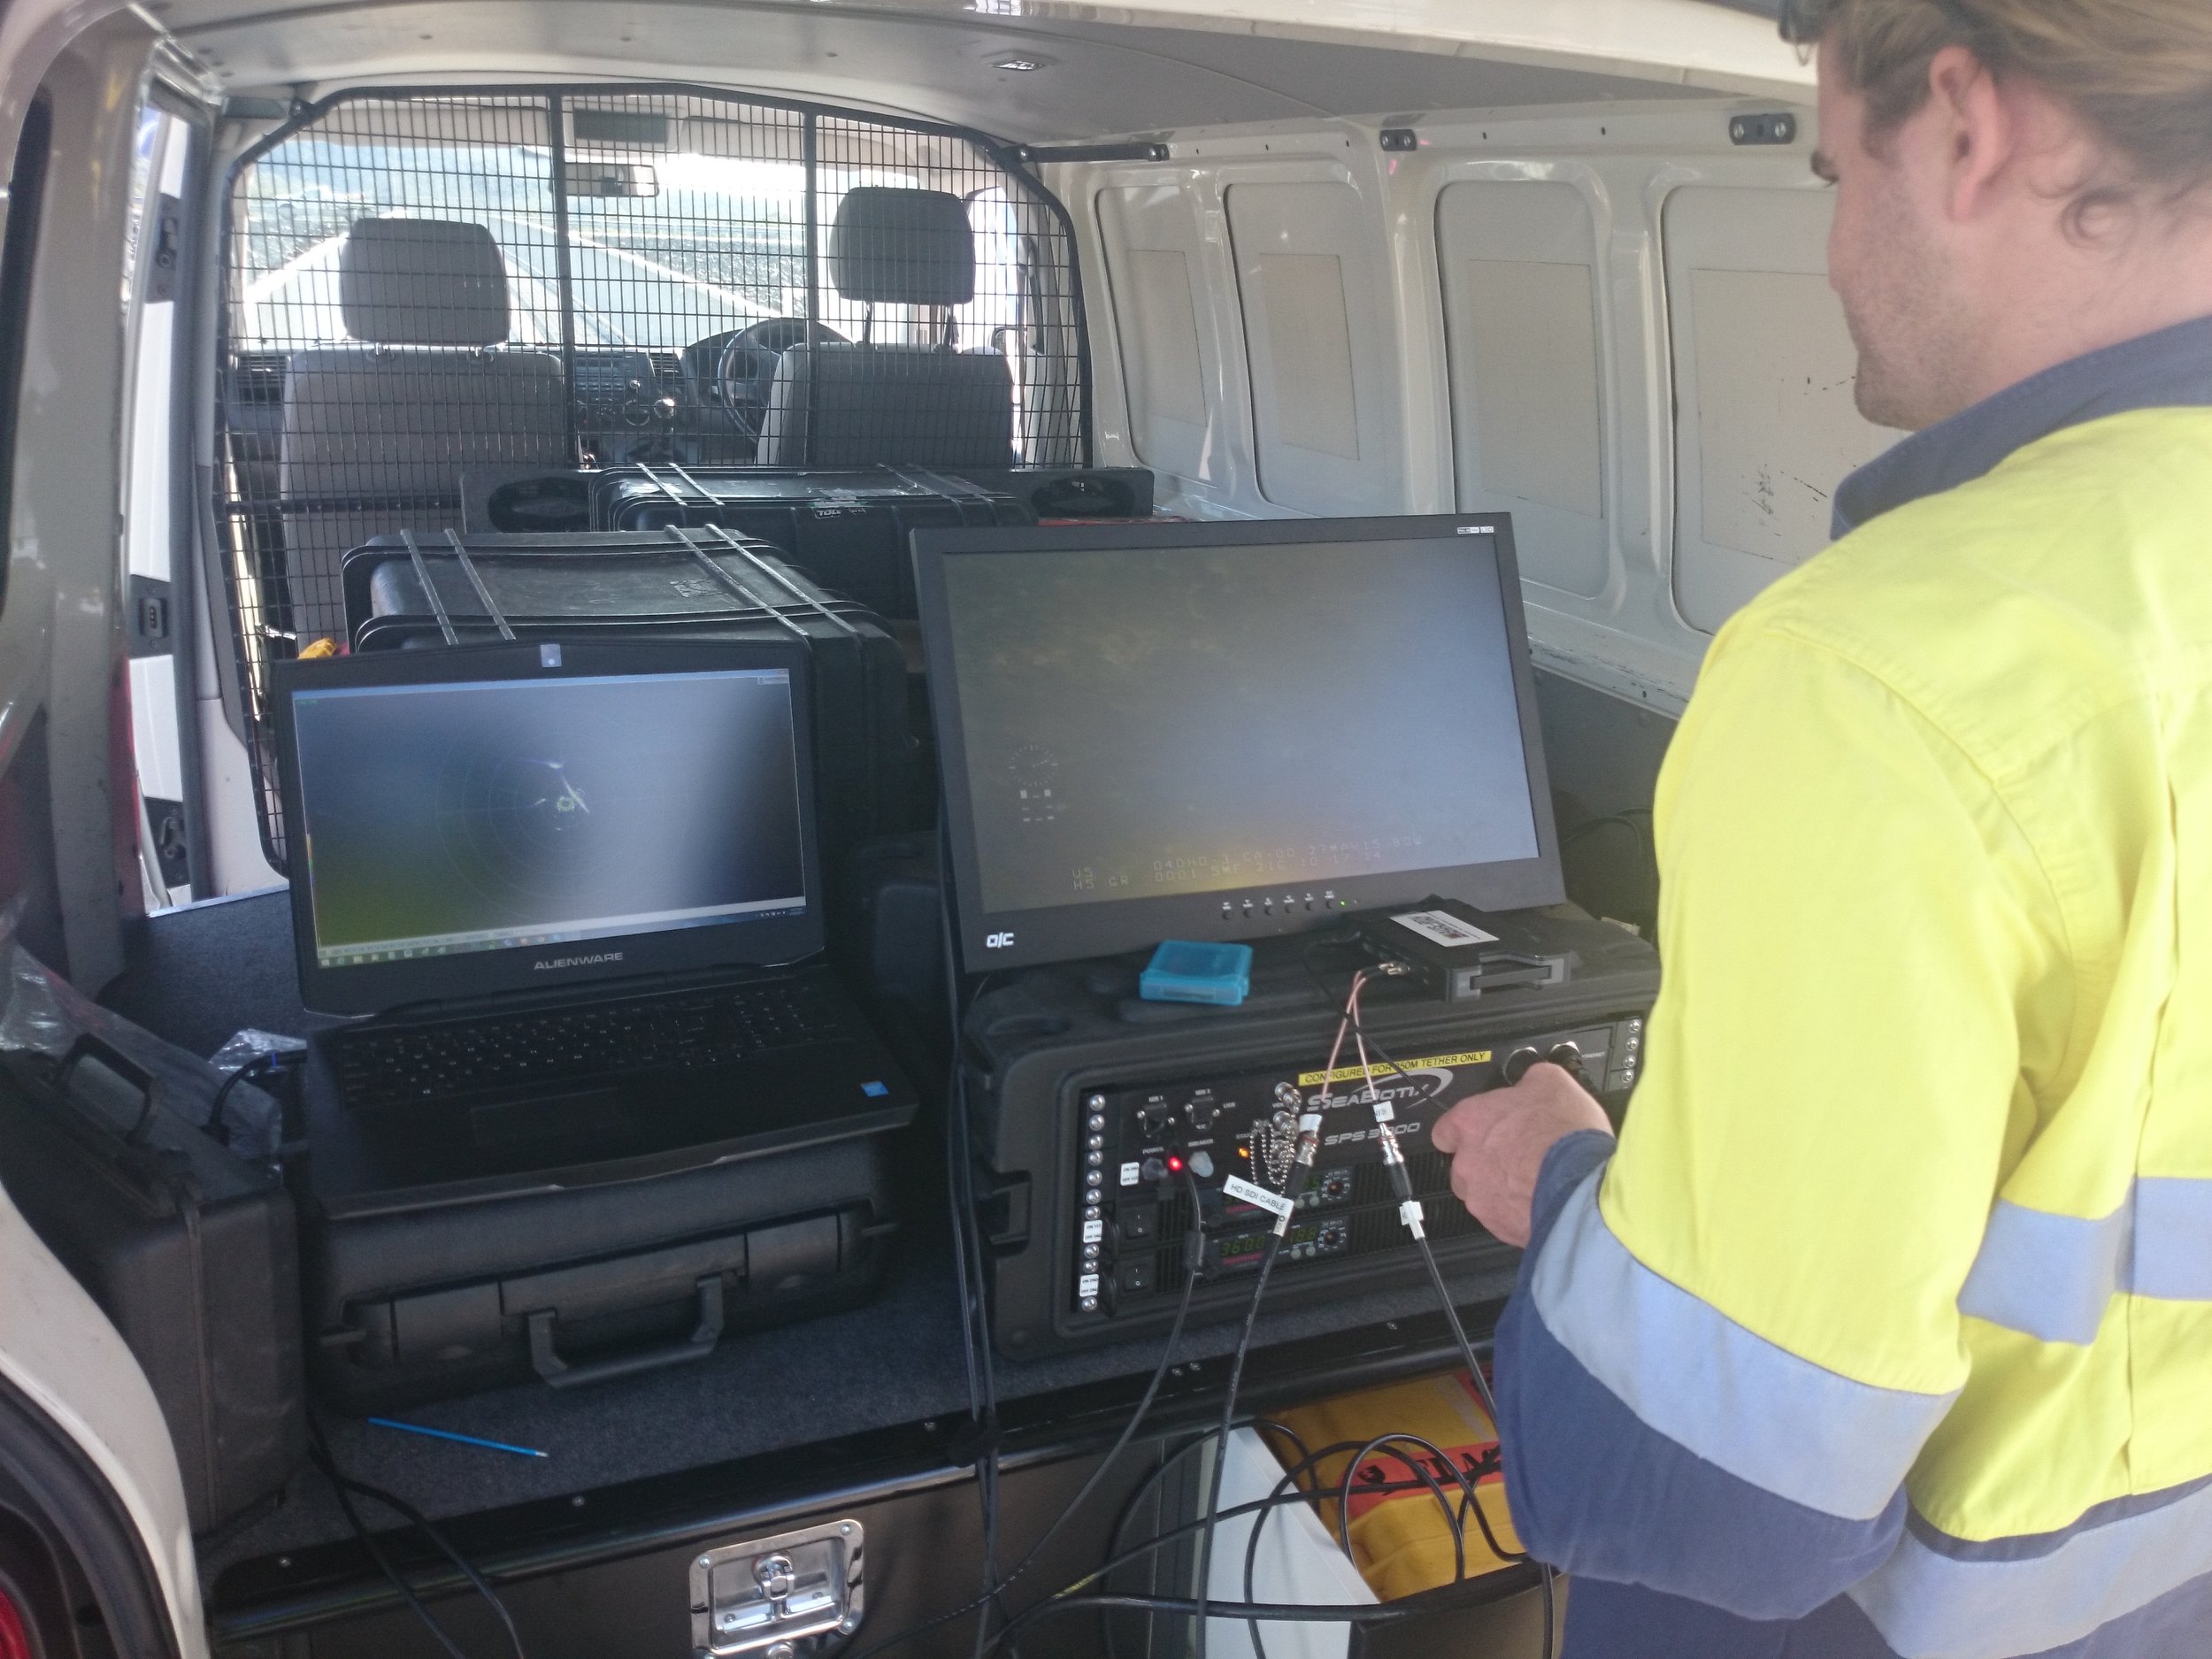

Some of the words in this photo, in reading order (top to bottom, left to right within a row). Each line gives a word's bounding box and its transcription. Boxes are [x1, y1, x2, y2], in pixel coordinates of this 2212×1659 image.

[534, 952, 623, 970] ALIENWARE
[1372, 1064, 1392, 1073] FOR
[1421, 1056, 1457, 1067] TETHER
[1460, 1053, 1485, 1063] ONLY
[1231, 1183, 1243, 1194] HD
[1244, 1189, 1259, 1200] SDI
[1259, 1195, 1286, 1211] CABLE
